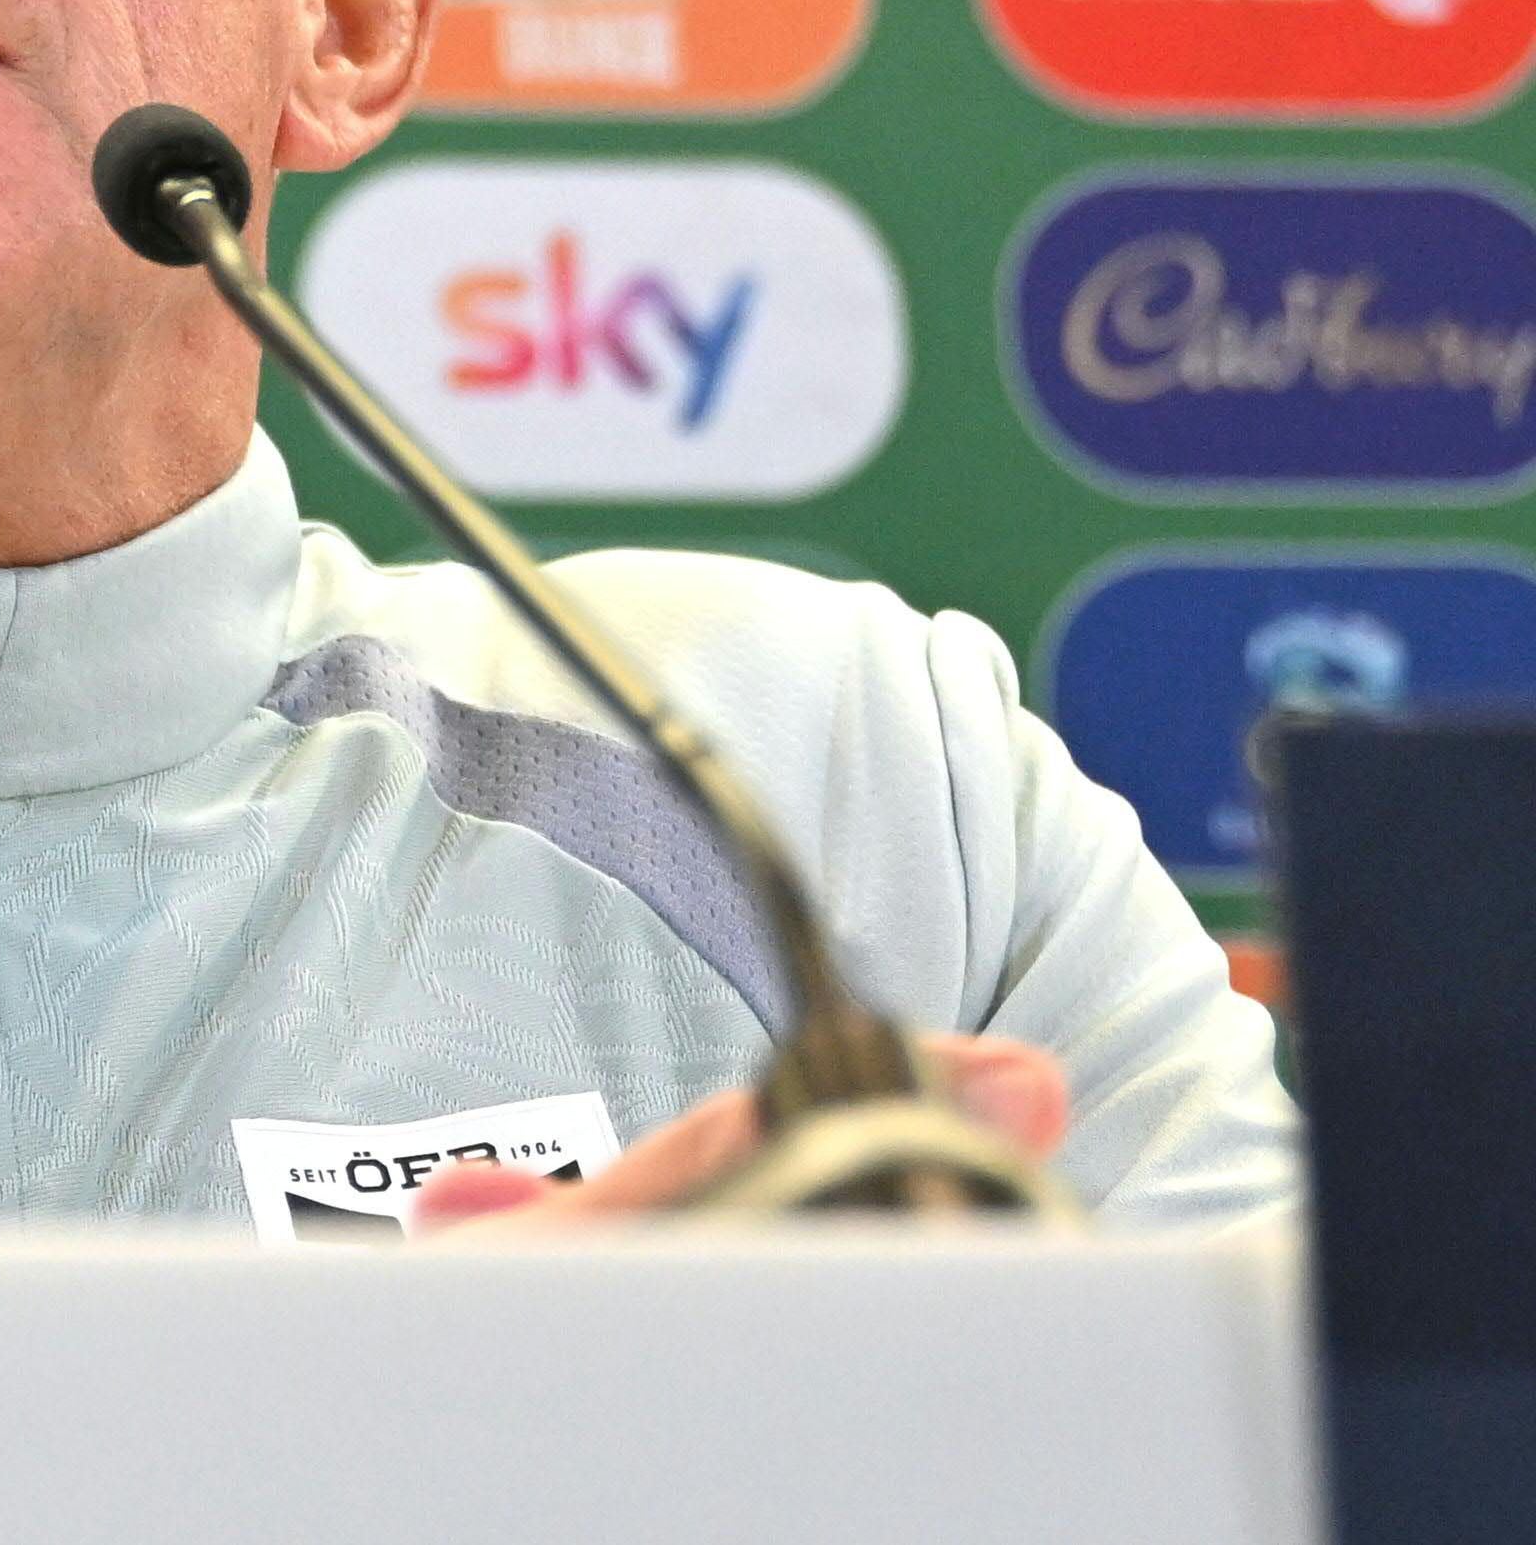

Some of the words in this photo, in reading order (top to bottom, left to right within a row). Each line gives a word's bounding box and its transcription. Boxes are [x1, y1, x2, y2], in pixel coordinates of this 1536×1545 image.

[437, 226, 763, 436] sky
[289, 1166, 338, 1184] SEIT
[510, 1139, 564, 1160] 1904
